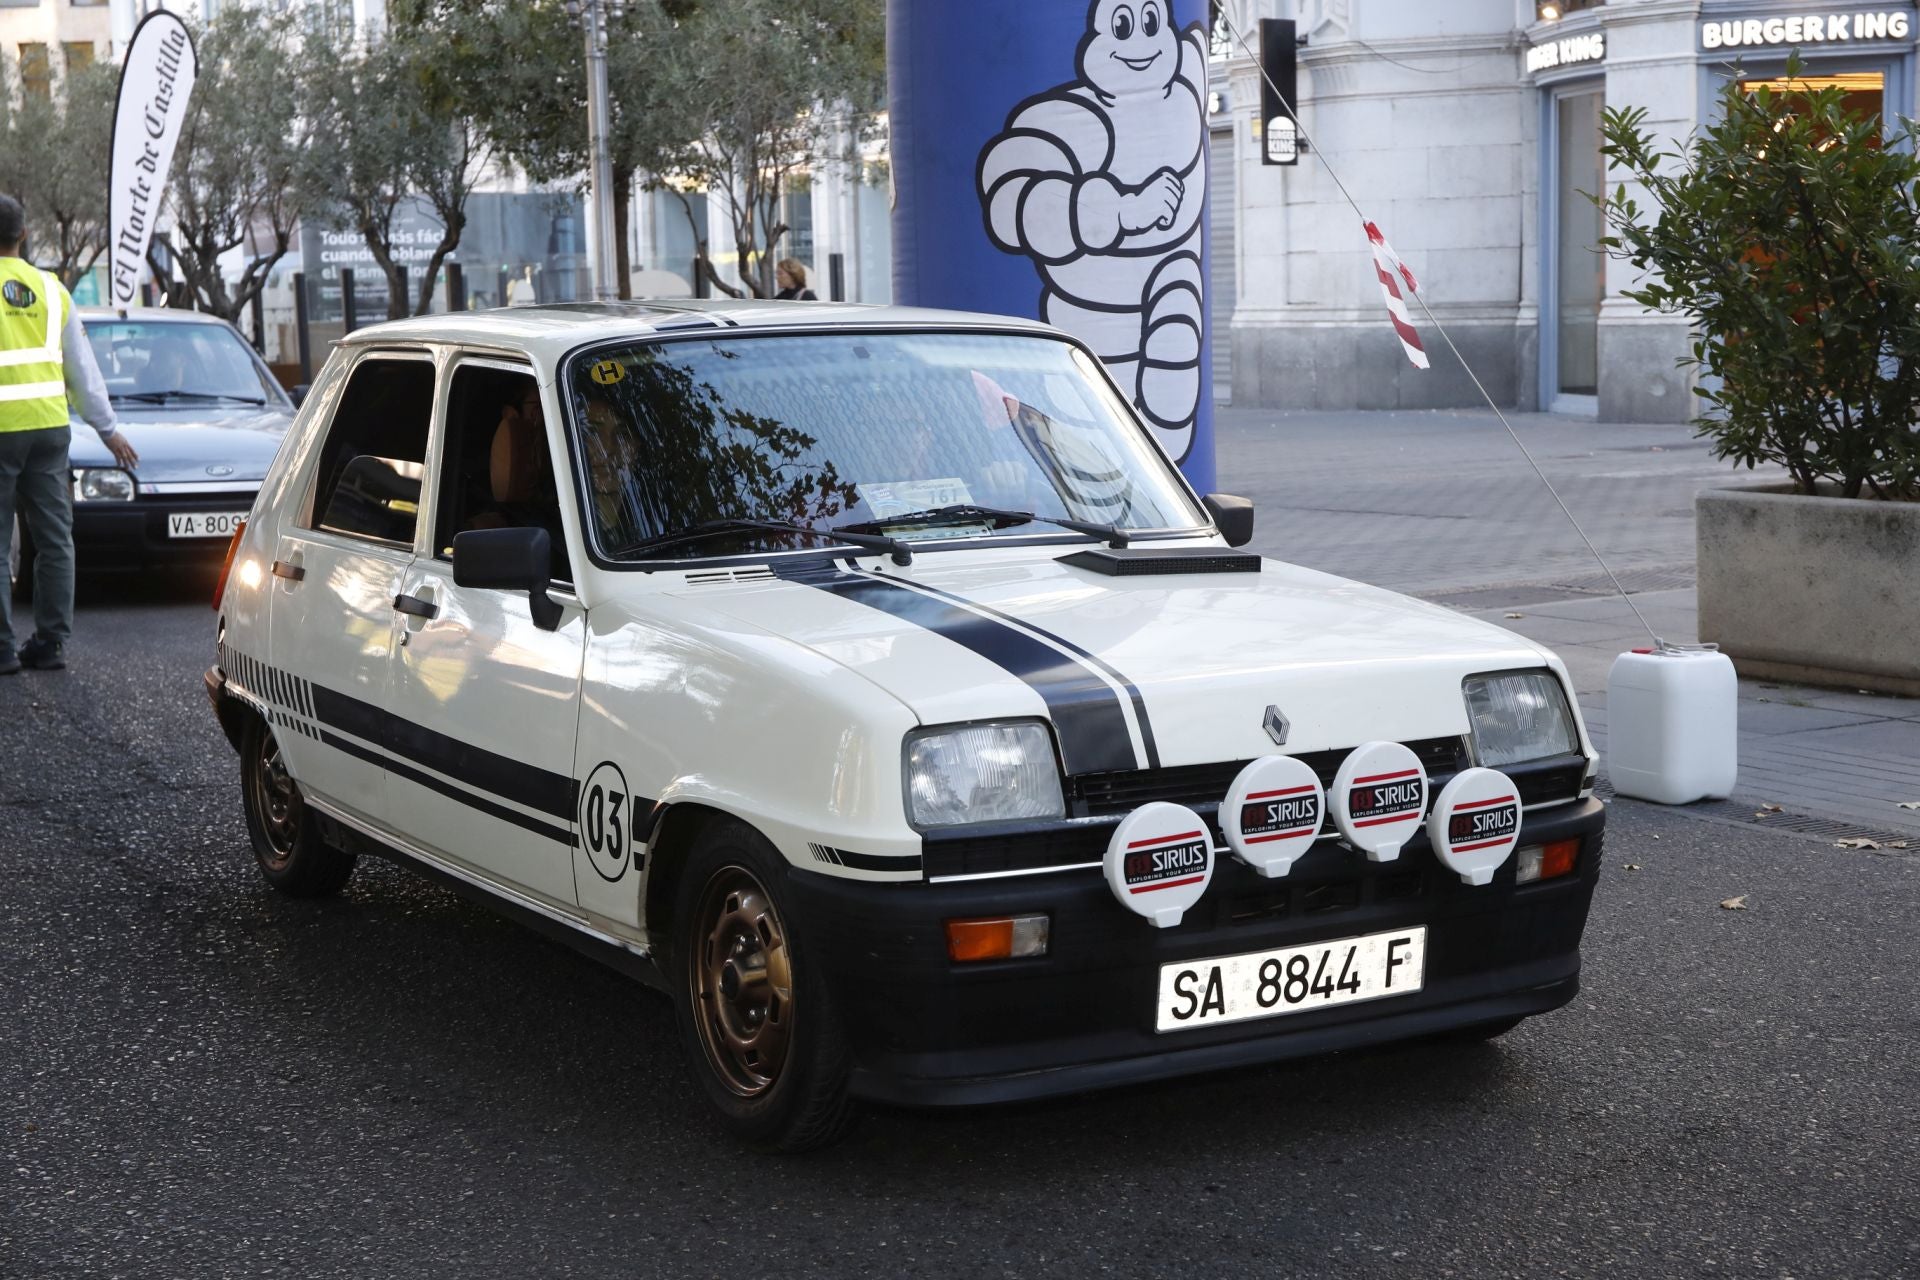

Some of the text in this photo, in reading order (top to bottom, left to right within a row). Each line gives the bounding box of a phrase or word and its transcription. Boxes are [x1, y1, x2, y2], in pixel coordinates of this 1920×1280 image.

[1702, 15, 1825, 48] BURGER
[1560, 33, 1604, 64] KING
[1268, 139, 1295, 153] KING
[114, 28, 186, 303] El Norte de Castilla
[320, 230, 358, 245] Todo
[416, 228, 446, 244] fáci
[321, 264, 337, 280] el
[597, 362, 620, 381] H
[171, 515, 250, 534] VA-809
[1374, 782, 1420, 807] SIRIUS
[586, 784, 625, 859] 03
[1267, 798, 1315, 823] SIRIUS
[1353, 808, 1384, 817] EXPLORING
[1472, 808, 1515, 833] SIRIUS
[1451, 835, 1481, 843] EXPLORING
[1151, 844, 1204, 872] SIRIUS
[1129, 873, 1163, 883] EXPLORING
[1184, 865, 1205, 873] VISION
[1171, 937, 1411, 1020] SA 8844 F
